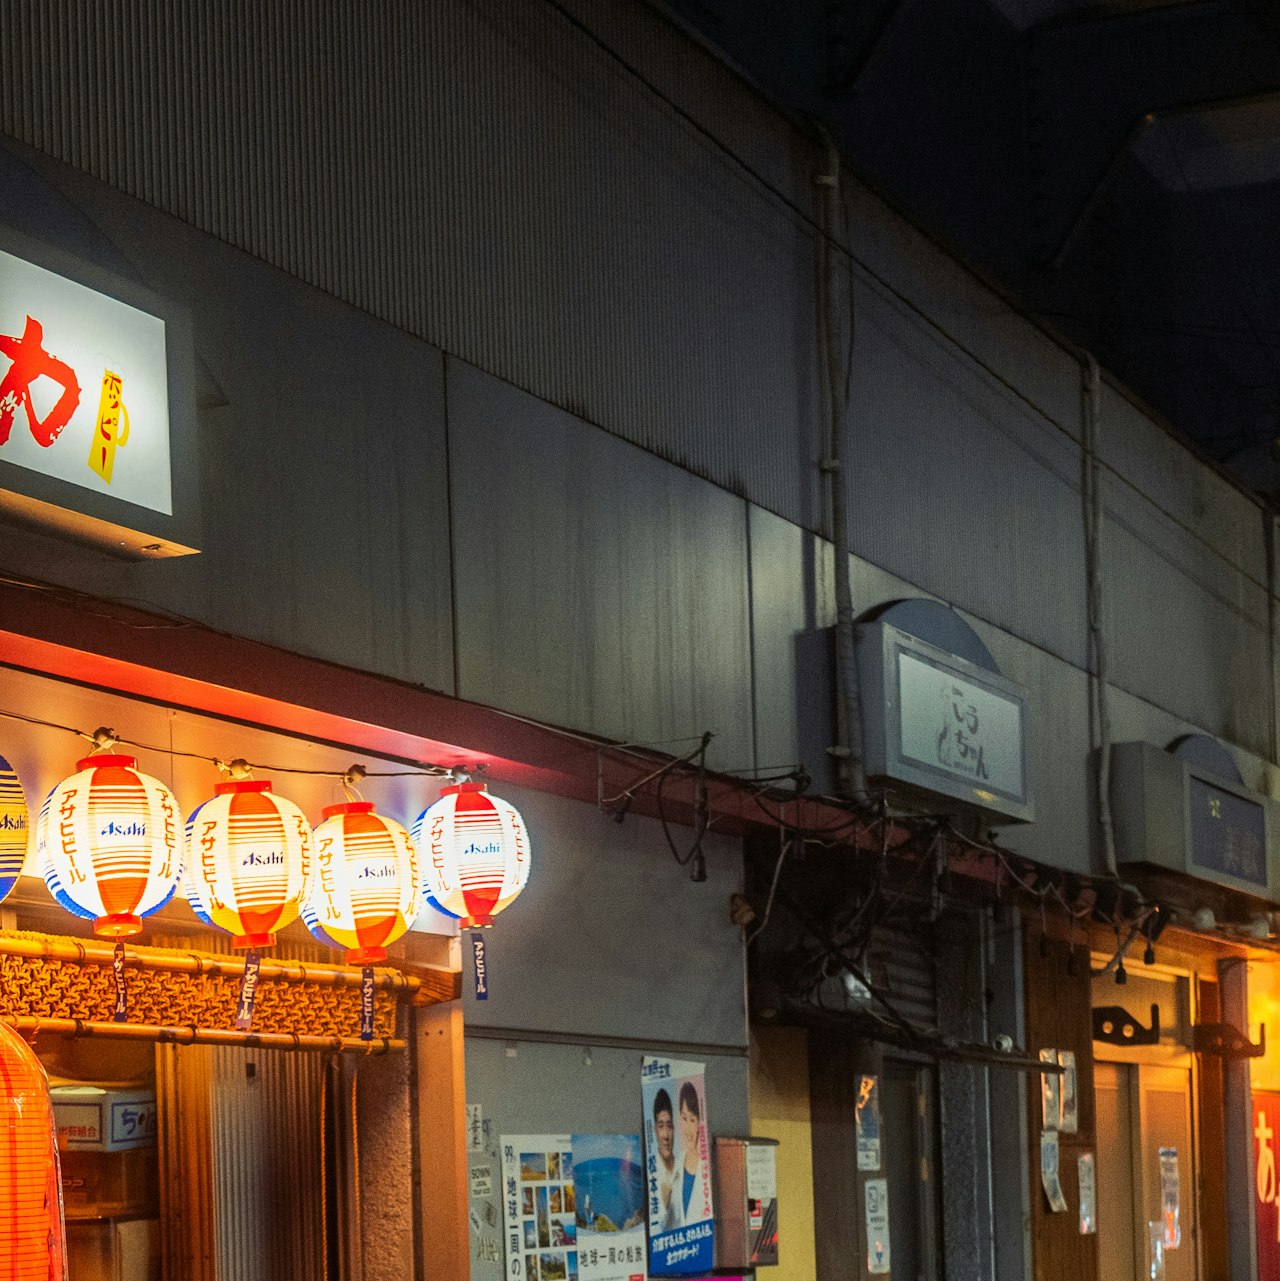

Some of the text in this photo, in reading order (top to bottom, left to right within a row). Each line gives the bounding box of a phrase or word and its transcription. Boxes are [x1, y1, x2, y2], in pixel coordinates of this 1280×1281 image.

[99, 373, 123, 472] ホッピー
[59, 789, 87, 885] アサヒビール
[101, 821, 146, 837] Asahi
[154, 788, 176, 879] アサヒビール
[464, 842, 500, 855] Asahi
[201, 821, 224, 910] アサヒビール
[242, 851, 284, 866] Asahi
[292, 815, 311, 903] アサヒビール
[318, 838, 341, 920] アサヒビール
[358, 865, 396, 879] Asahi
[114, 951, 126, 1013] アサヒビール
[238, 963, 259, 1020] アサヒビール
[474, 941, 486, 993] アサヒビール
[363, 978, 374, 1033] アサヒビール
[580, 1244, 643, 1267] 地球一周の船旅
